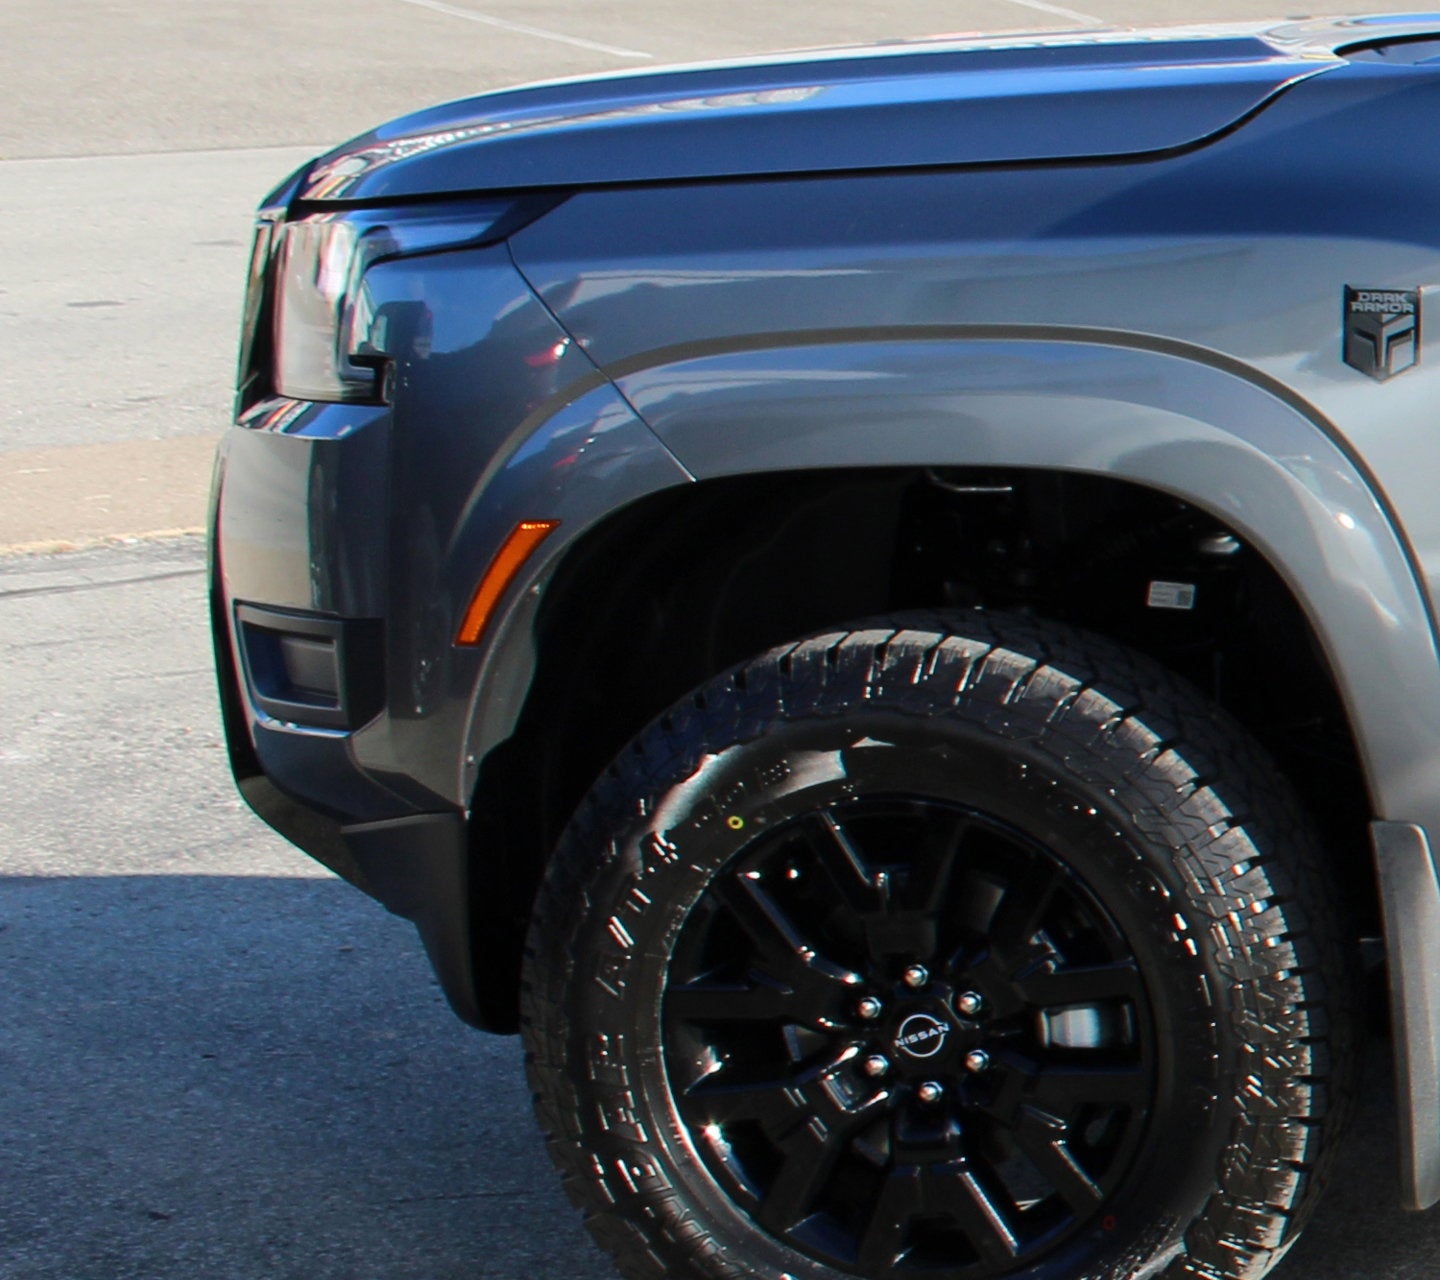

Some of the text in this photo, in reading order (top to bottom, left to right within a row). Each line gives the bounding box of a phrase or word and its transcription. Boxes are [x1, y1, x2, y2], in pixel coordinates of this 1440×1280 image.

[1358, 292, 1408, 303] DARK
[1351, 302, 1415, 313] ARMOR
[893, 1022, 950, 1048] NISSAN
